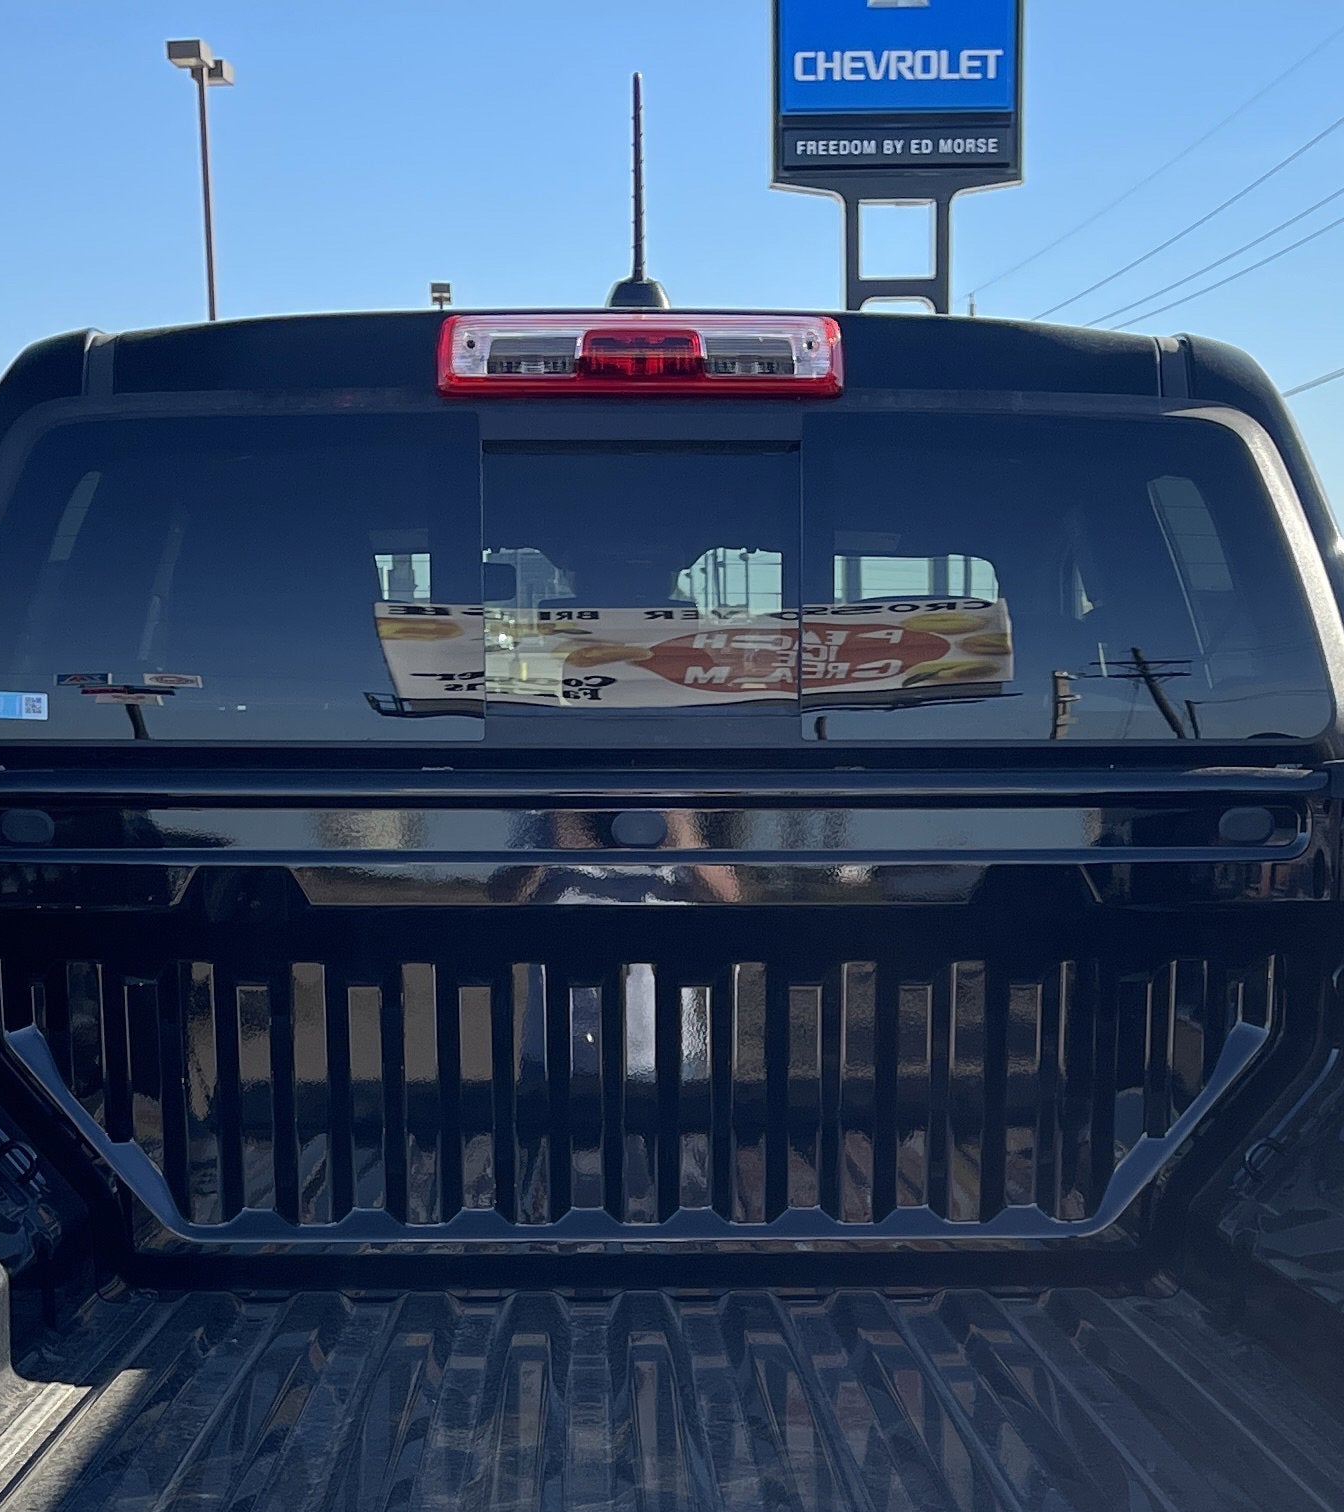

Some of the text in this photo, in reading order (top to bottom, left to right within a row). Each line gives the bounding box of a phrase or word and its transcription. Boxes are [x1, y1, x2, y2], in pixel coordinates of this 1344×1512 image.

[793, 49, 1004, 82] CHEVROLET
[796, 138, 999, 155] FREEDOM BY ED MORSE
